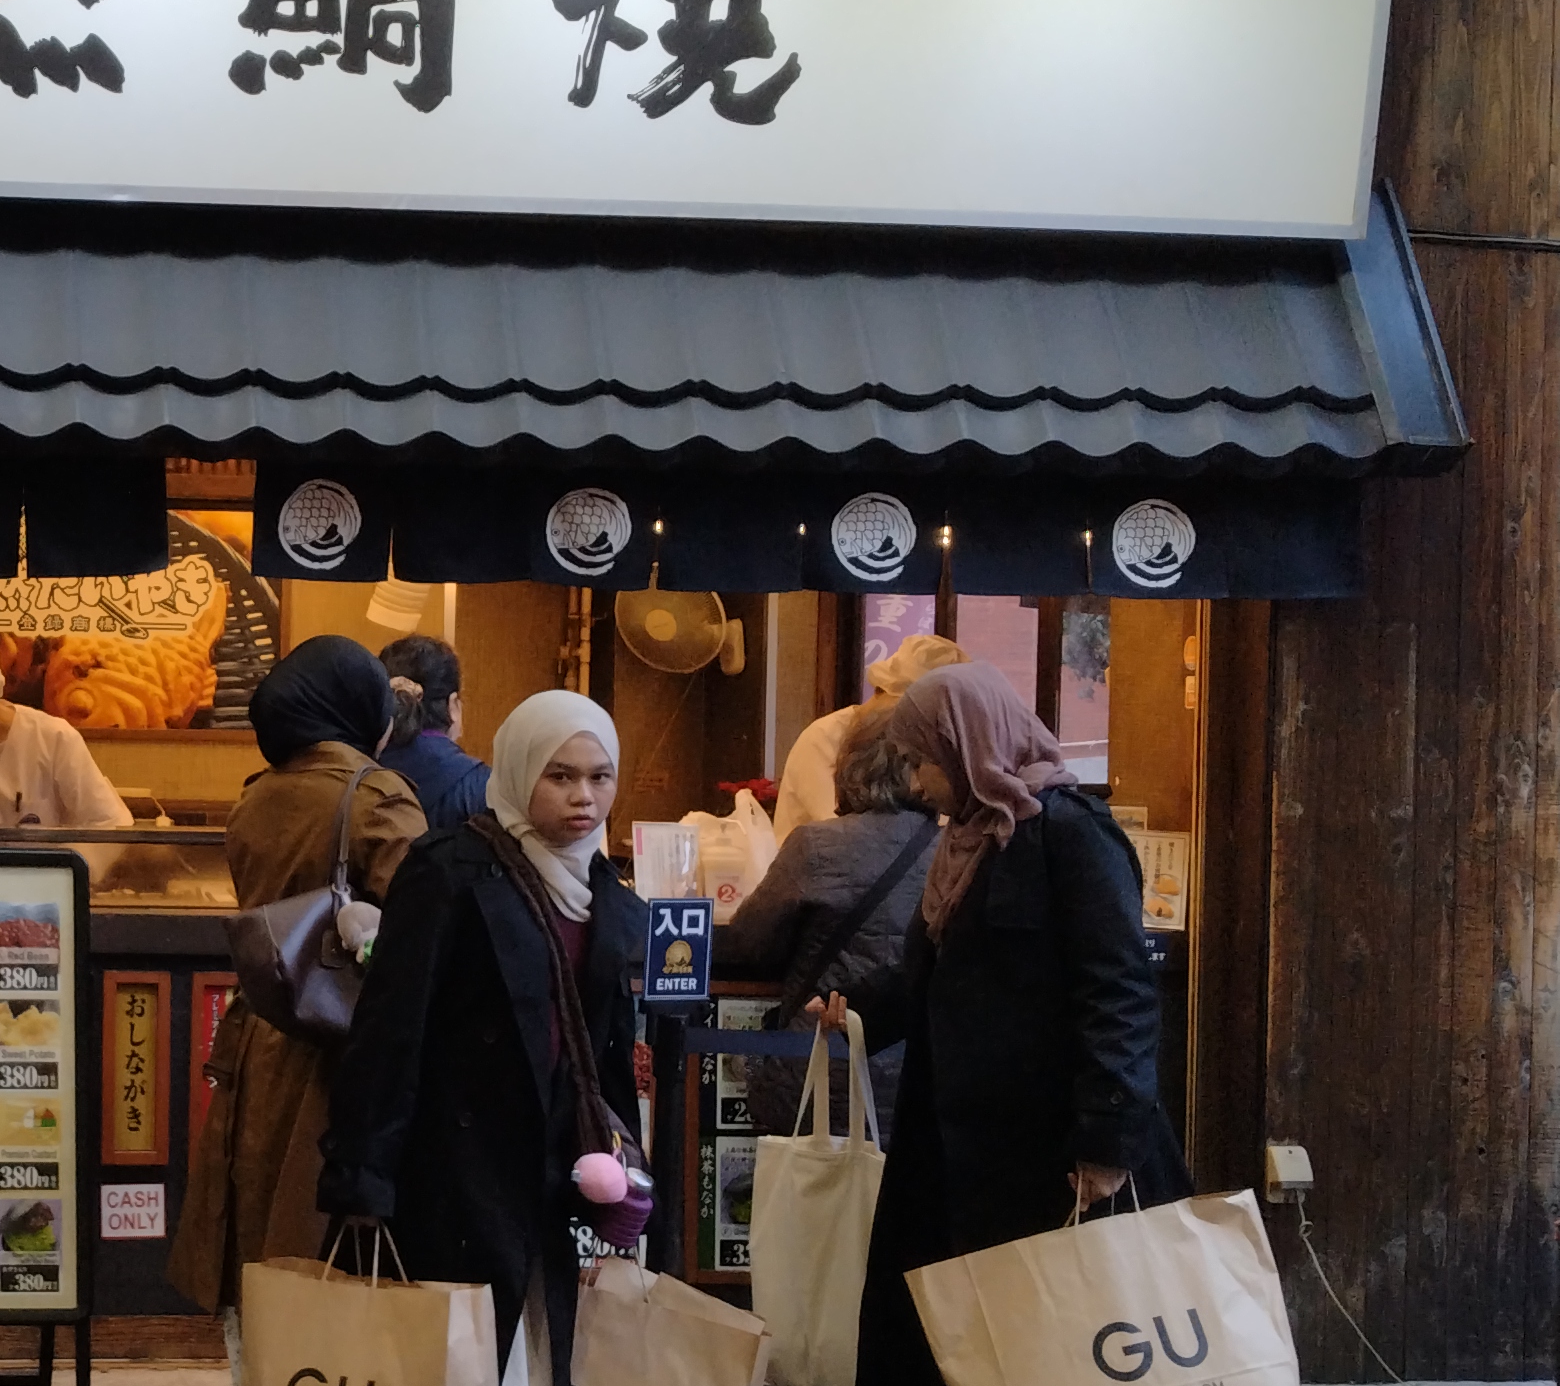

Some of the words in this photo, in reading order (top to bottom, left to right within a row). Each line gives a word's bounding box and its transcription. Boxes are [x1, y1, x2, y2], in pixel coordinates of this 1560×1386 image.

[654, 908, 706, 936] 入口
[7, 951, 25, 960] Red
[655, 977, 698, 991] ENTER
[123, 993, 147, 1132] おしながき
[106, 1191, 159, 1209] CASH
[108, 1213, 158, 1230] ONLY
[1092, 1308, 1209, 1383] GU
